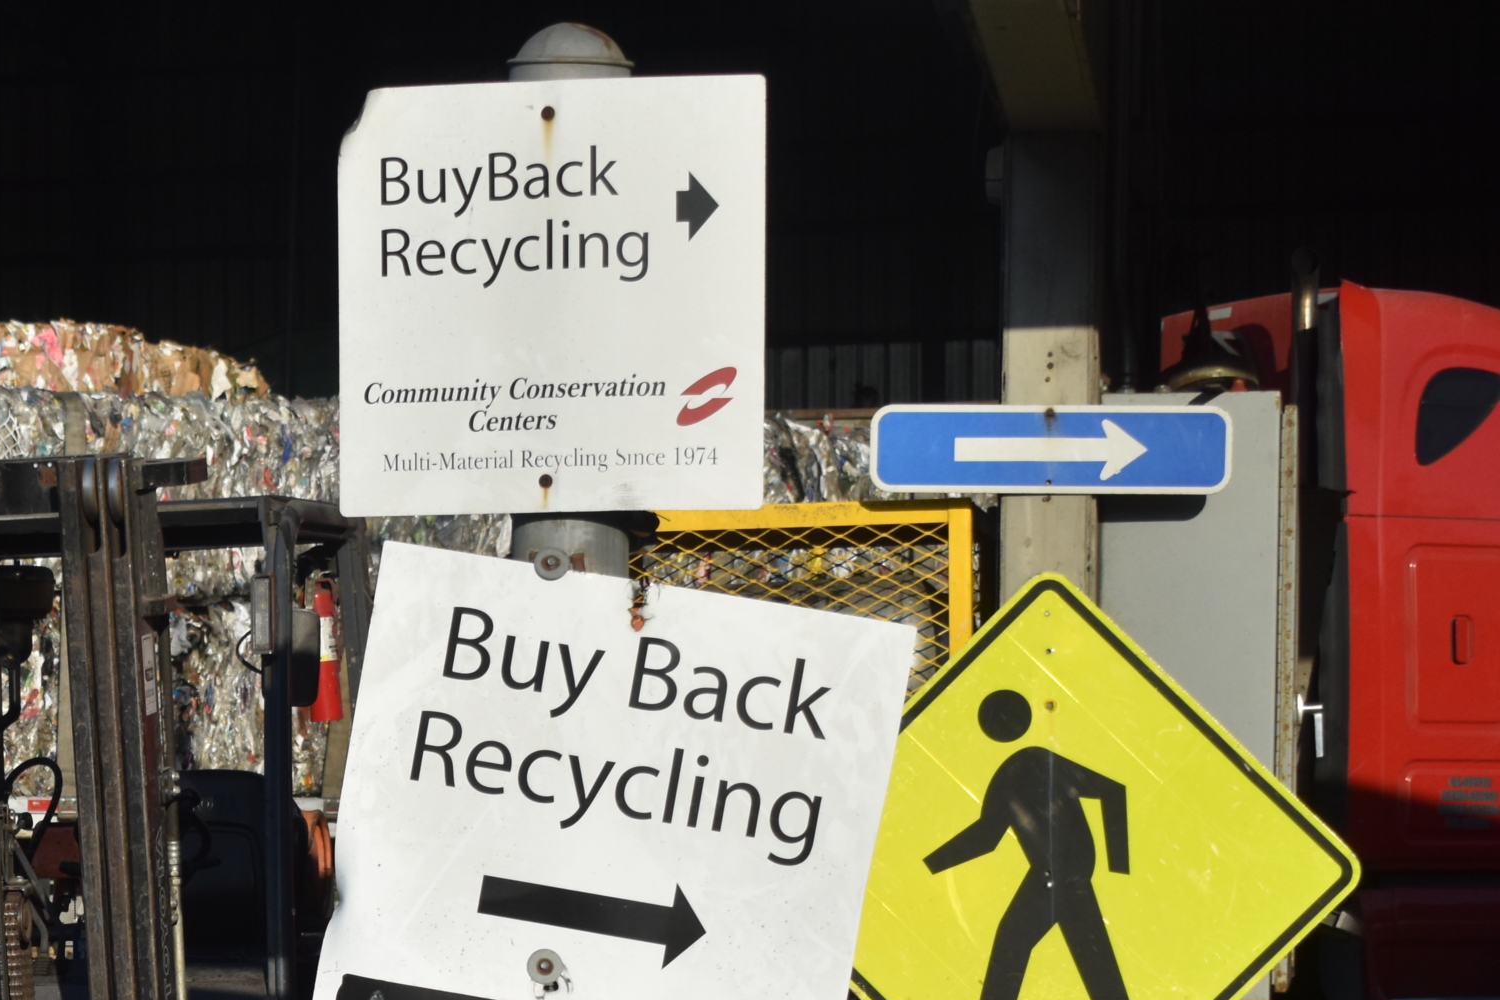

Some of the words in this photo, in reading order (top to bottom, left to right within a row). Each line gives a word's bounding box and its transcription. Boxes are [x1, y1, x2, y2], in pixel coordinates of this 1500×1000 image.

[380, 145, 619, 218] BuyBack
[380, 219, 650, 289] Recycling
[363, 378, 501, 409] Community
[508, 373, 666, 400] Conservation
[468, 409, 558, 433] Centers
[382, 449, 514, 473] Multi-Material
[520, 448, 608, 474] Recycling
[614, 447, 666, 467] Since
[673, 446, 719, 467] 1974
[442, 606, 606, 718] Buy
[628, 636, 833, 740] Back
[409, 710, 823, 867] Recycling
